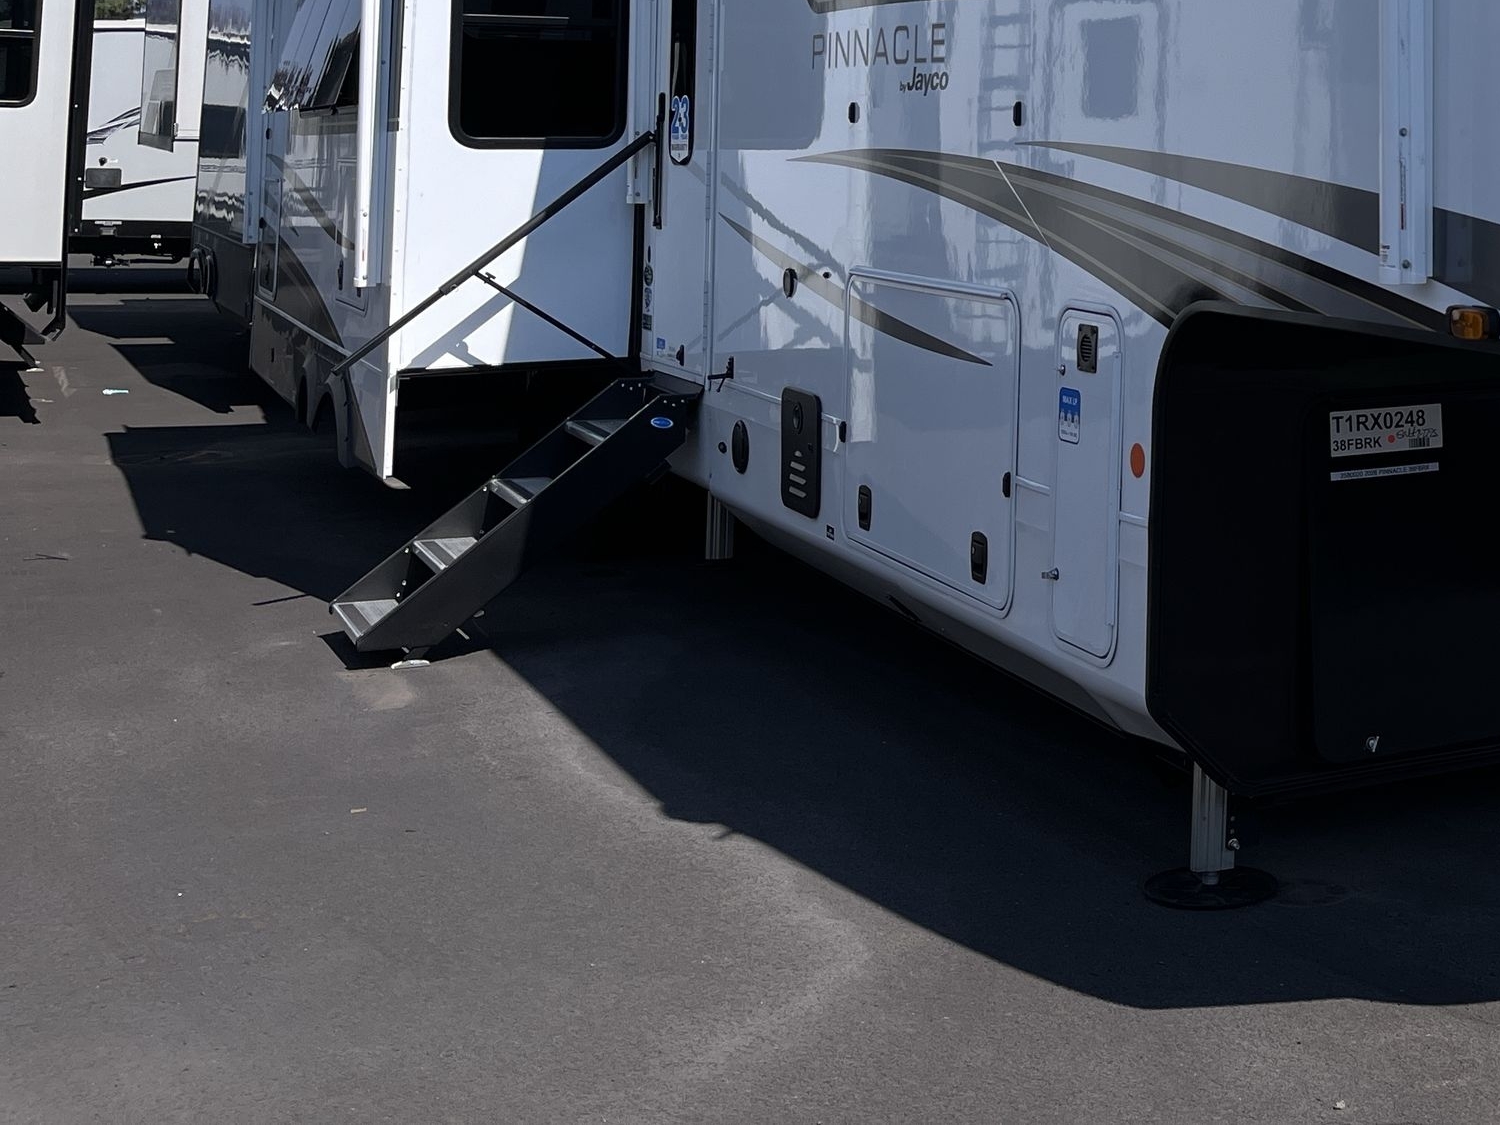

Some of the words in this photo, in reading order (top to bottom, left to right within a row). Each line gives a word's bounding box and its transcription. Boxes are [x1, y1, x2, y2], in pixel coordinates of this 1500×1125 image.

[812, 22, 946, 70] PINNACLE
[900, 80, 907, 93] by
[907, 66, 949, 96] Jayco
[1332, 410, 1425, 433] T1RX0248
[1332, 436, 1382, 452] 38FBRK
